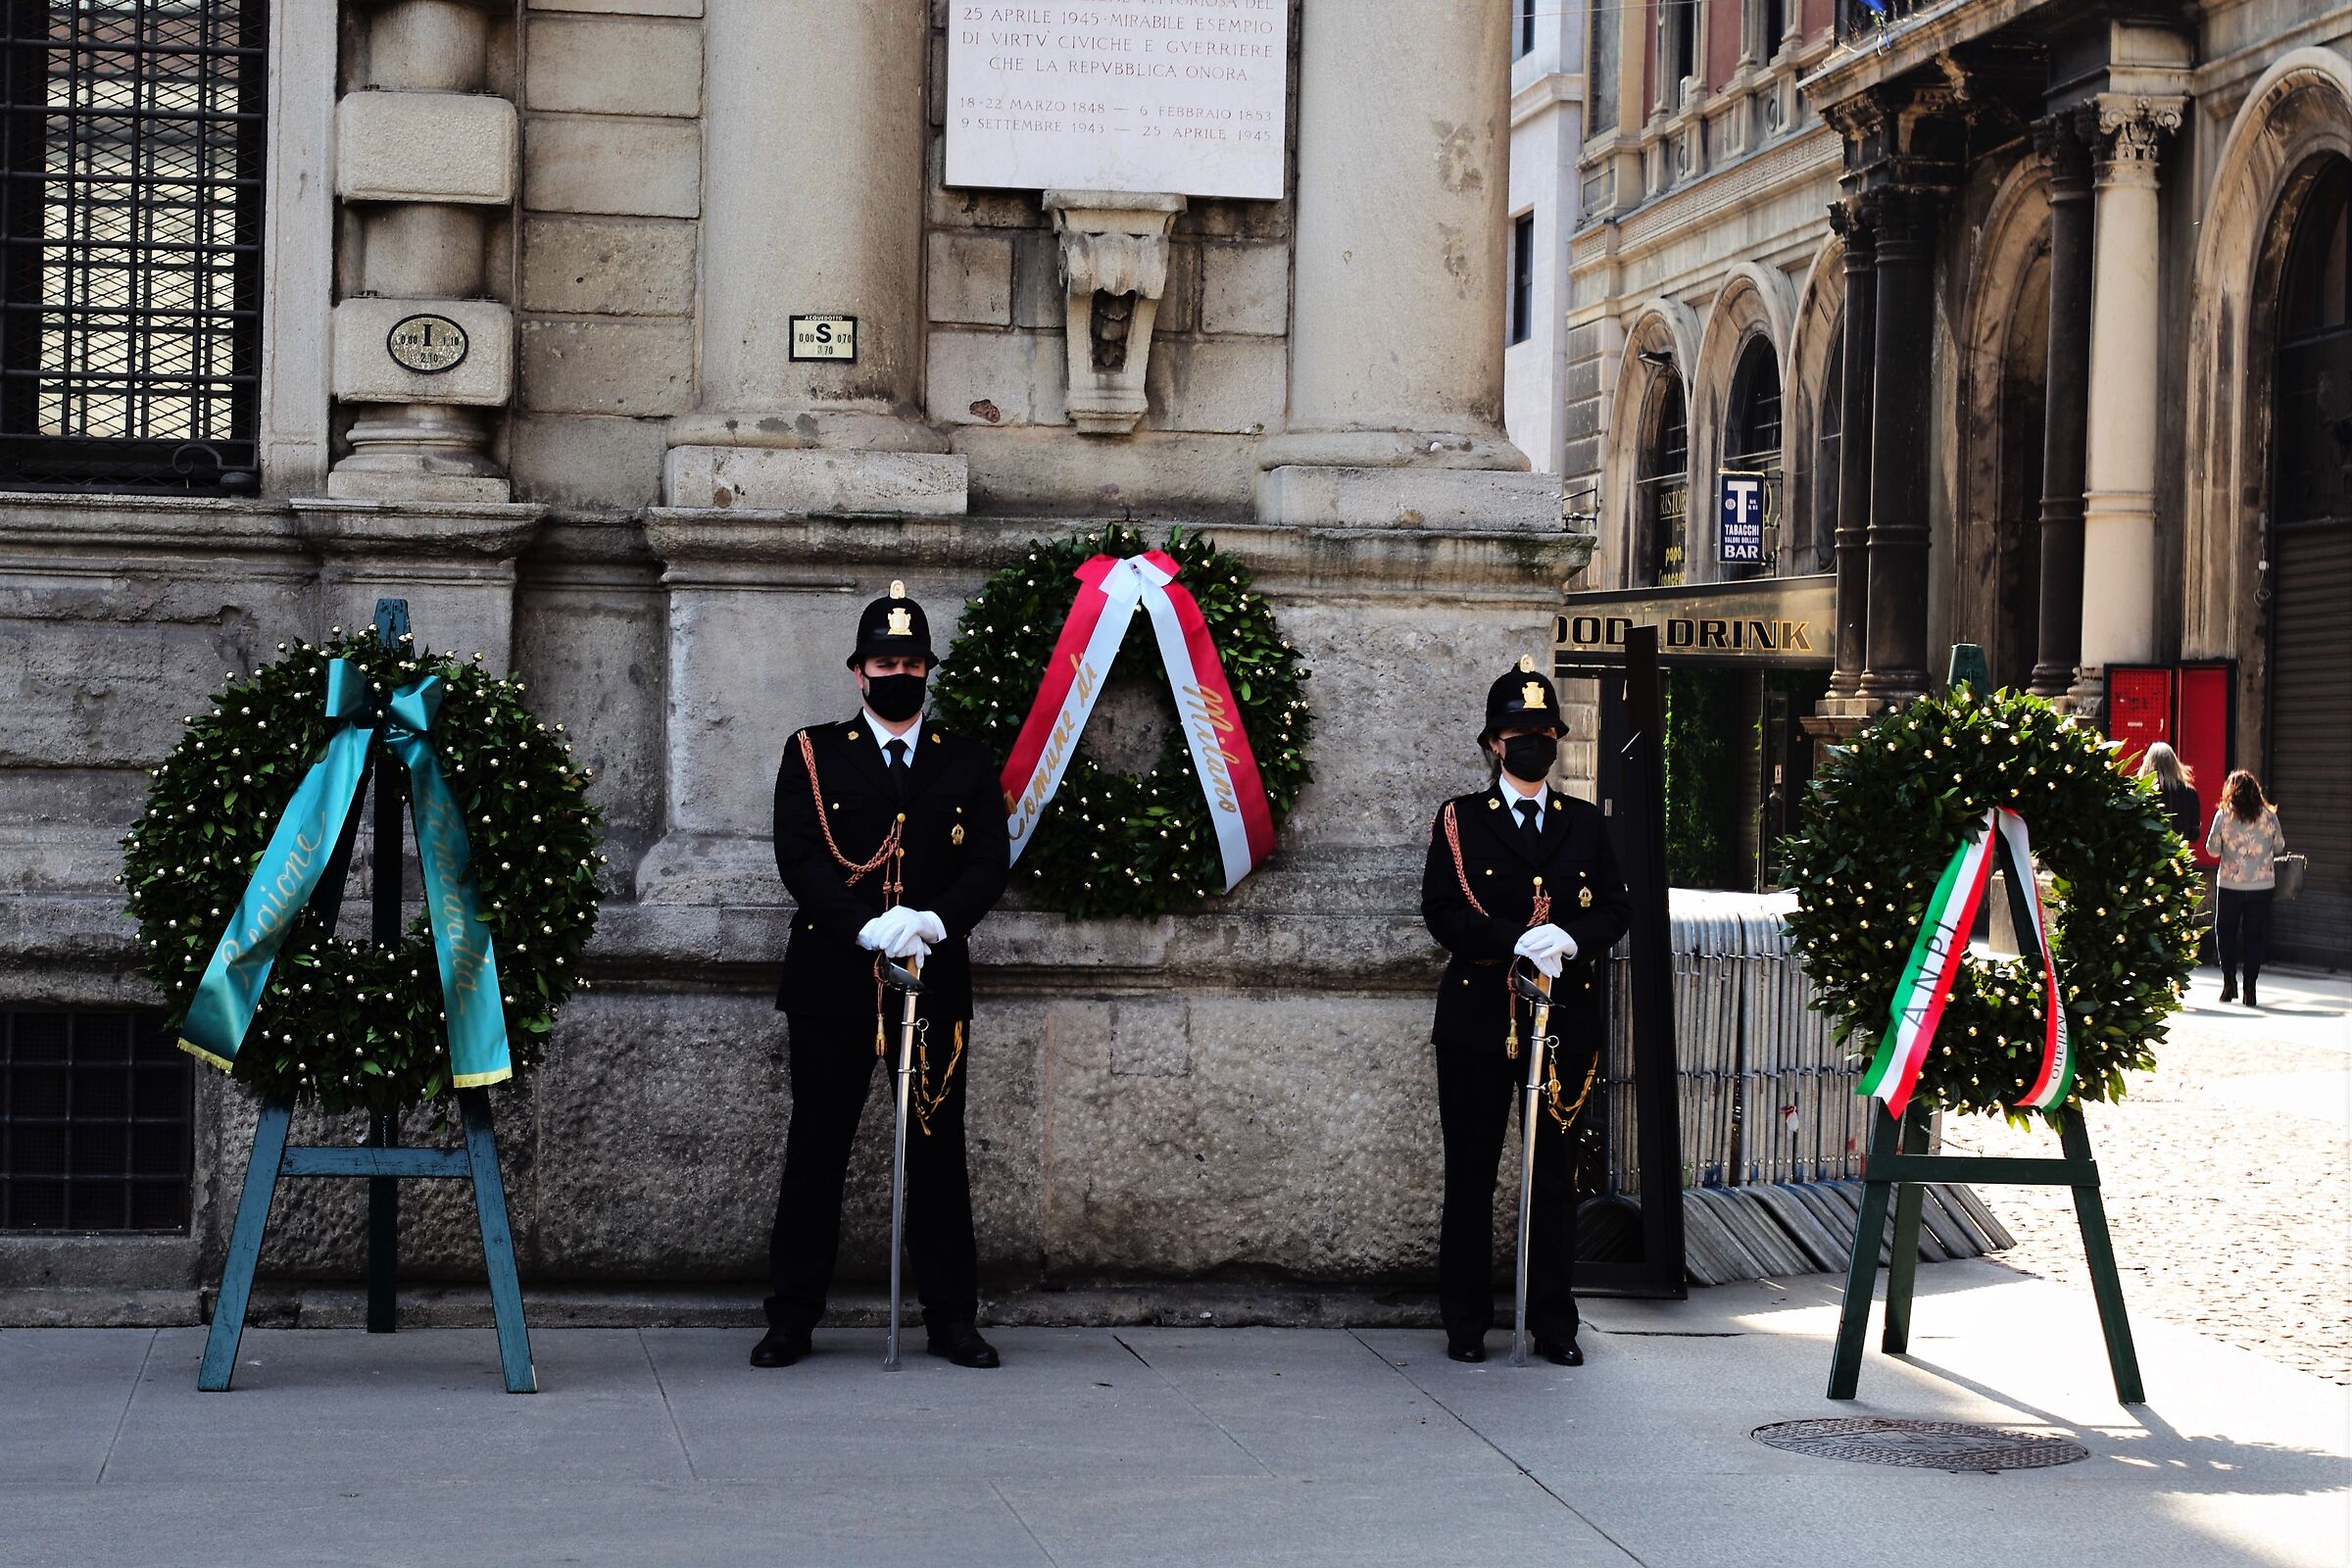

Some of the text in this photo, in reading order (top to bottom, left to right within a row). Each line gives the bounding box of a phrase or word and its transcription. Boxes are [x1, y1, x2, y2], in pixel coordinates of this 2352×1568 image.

[963, 7, 983, 21] 25
[991, 9, 1052, 24] APRILE
[1109, 14, 1185, 30] MIRABILE
[1196, 18, 1273, 34] ESEMPIO
[962, 31, 980, 45] DI
[1058, 35, 1132, 52] CIVICHE
[1145, 39, 1153, 52] E
[1166, 40, 1273, 58] GVERRIERE
[989, 57, 1248, 81] CHE LA REPVBBLICA ONORA
[1009, 99, 1066, 113] MARZO
[1073, 102, 1105, 114] 1848
[1140, 104, 1149, 117] 6
[1158, 106, 1232, 120] FEBBRAIO
[1240, 110, 1271, 122] 1853
[961, 118, 969, 128] 9
[978, 119, 1062, 132] SETTEMBRE
[1073, 122, 1104, 134] 1943
[1143, 125, 1161, 137] 25
[1172, 127, 1226, 140] APRILE
[1238, 130, 1271, 142] 1945
[422, 323, 433, 347] I
[815, 322, 832, 344] S
[1727, 480, 1758, 523] T
[1724, 523, 1759, 536] TABACCHI
[1724, 544, 1759, 559] BAR
[1666, 618, 1813, 652] DRINK
[1069, 652, 1098, 708] di
[1182, 684, 1241, 813] Milano
[220, 810, 325, 990] Regione
[2051, 1015, 2068, 1081] Milano
